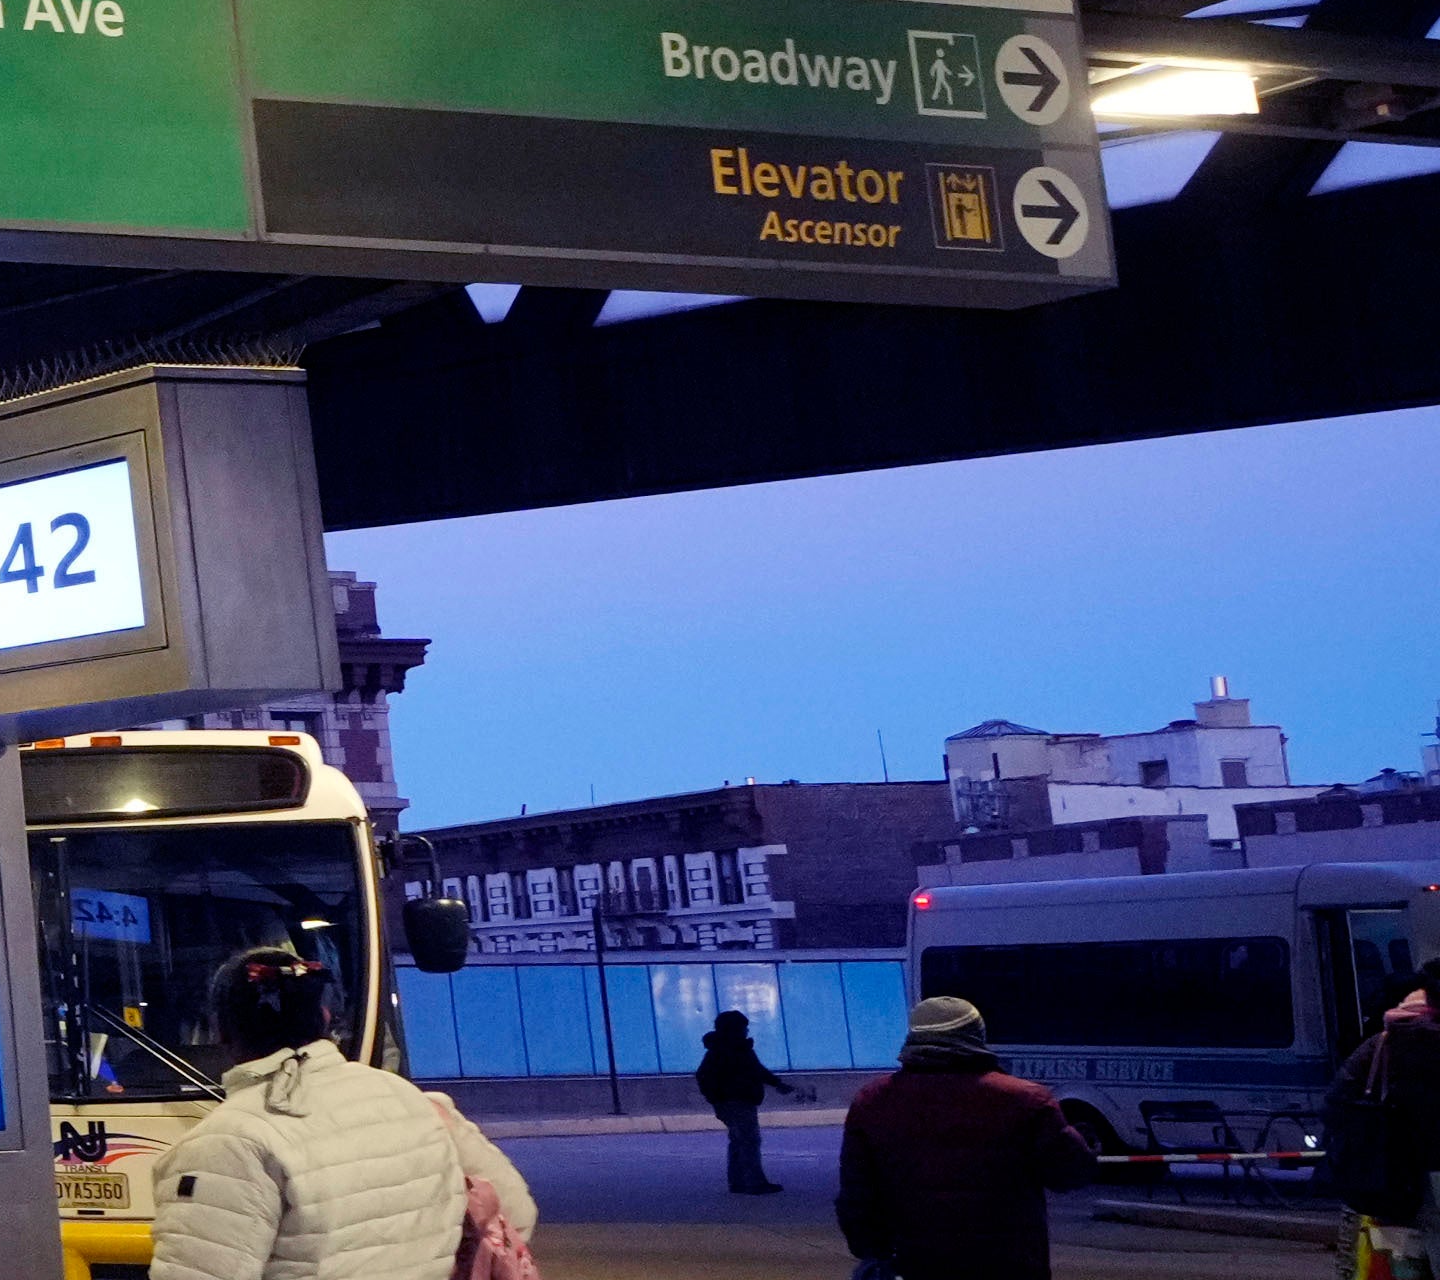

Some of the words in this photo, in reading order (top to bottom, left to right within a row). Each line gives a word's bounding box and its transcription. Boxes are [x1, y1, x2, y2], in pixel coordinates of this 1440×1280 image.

[660, 32, 898, 105] Broadway
[710, 147, 904, 206] Elevator
[759, 210, 902, 248] Ascensor
[1095, 1058, 1176, 1082] SERVICE
